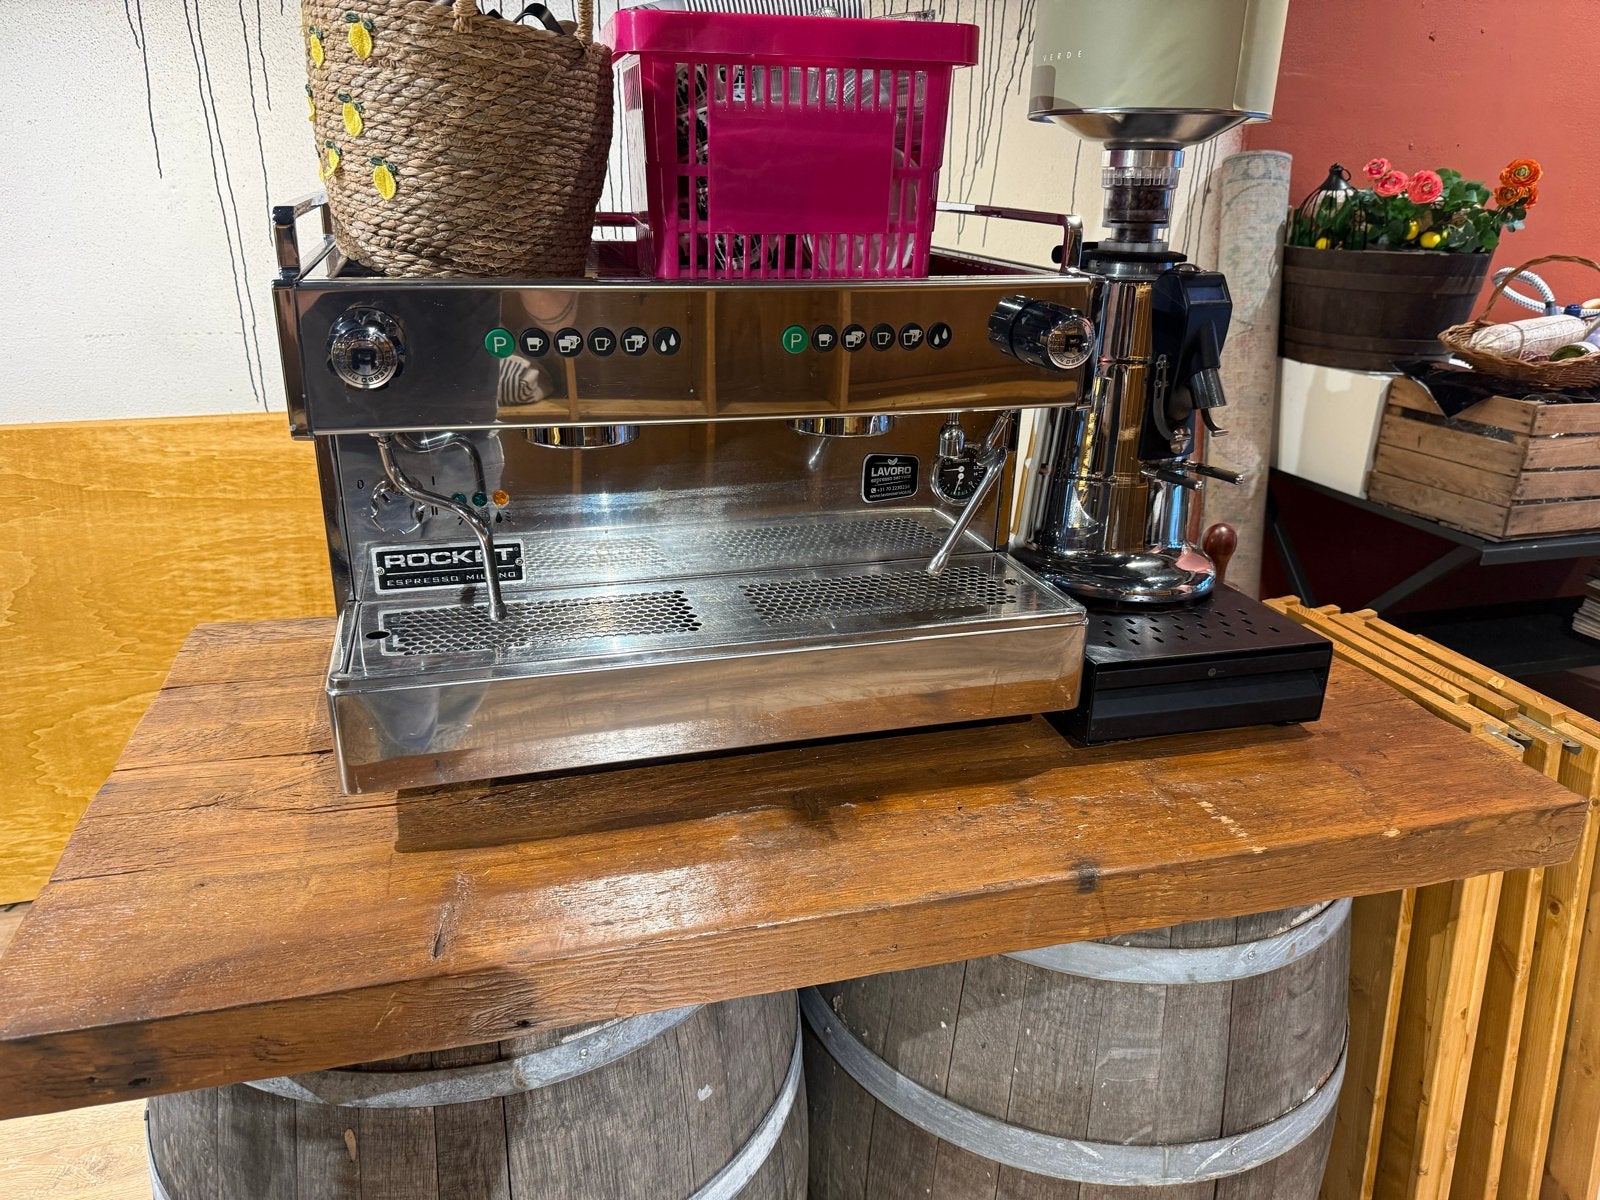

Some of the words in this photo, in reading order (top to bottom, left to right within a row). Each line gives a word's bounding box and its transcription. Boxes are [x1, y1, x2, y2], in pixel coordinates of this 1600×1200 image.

[1042, 50, 1083, 62] VERDE
[493, 336, 507, 353] P
[791, 333, 802, 349] P
[871, 466, 911, 477] LAVORO
[387, 576, 459, 587] ESPRESSO
[466, 571, 516, 581] MILNO
